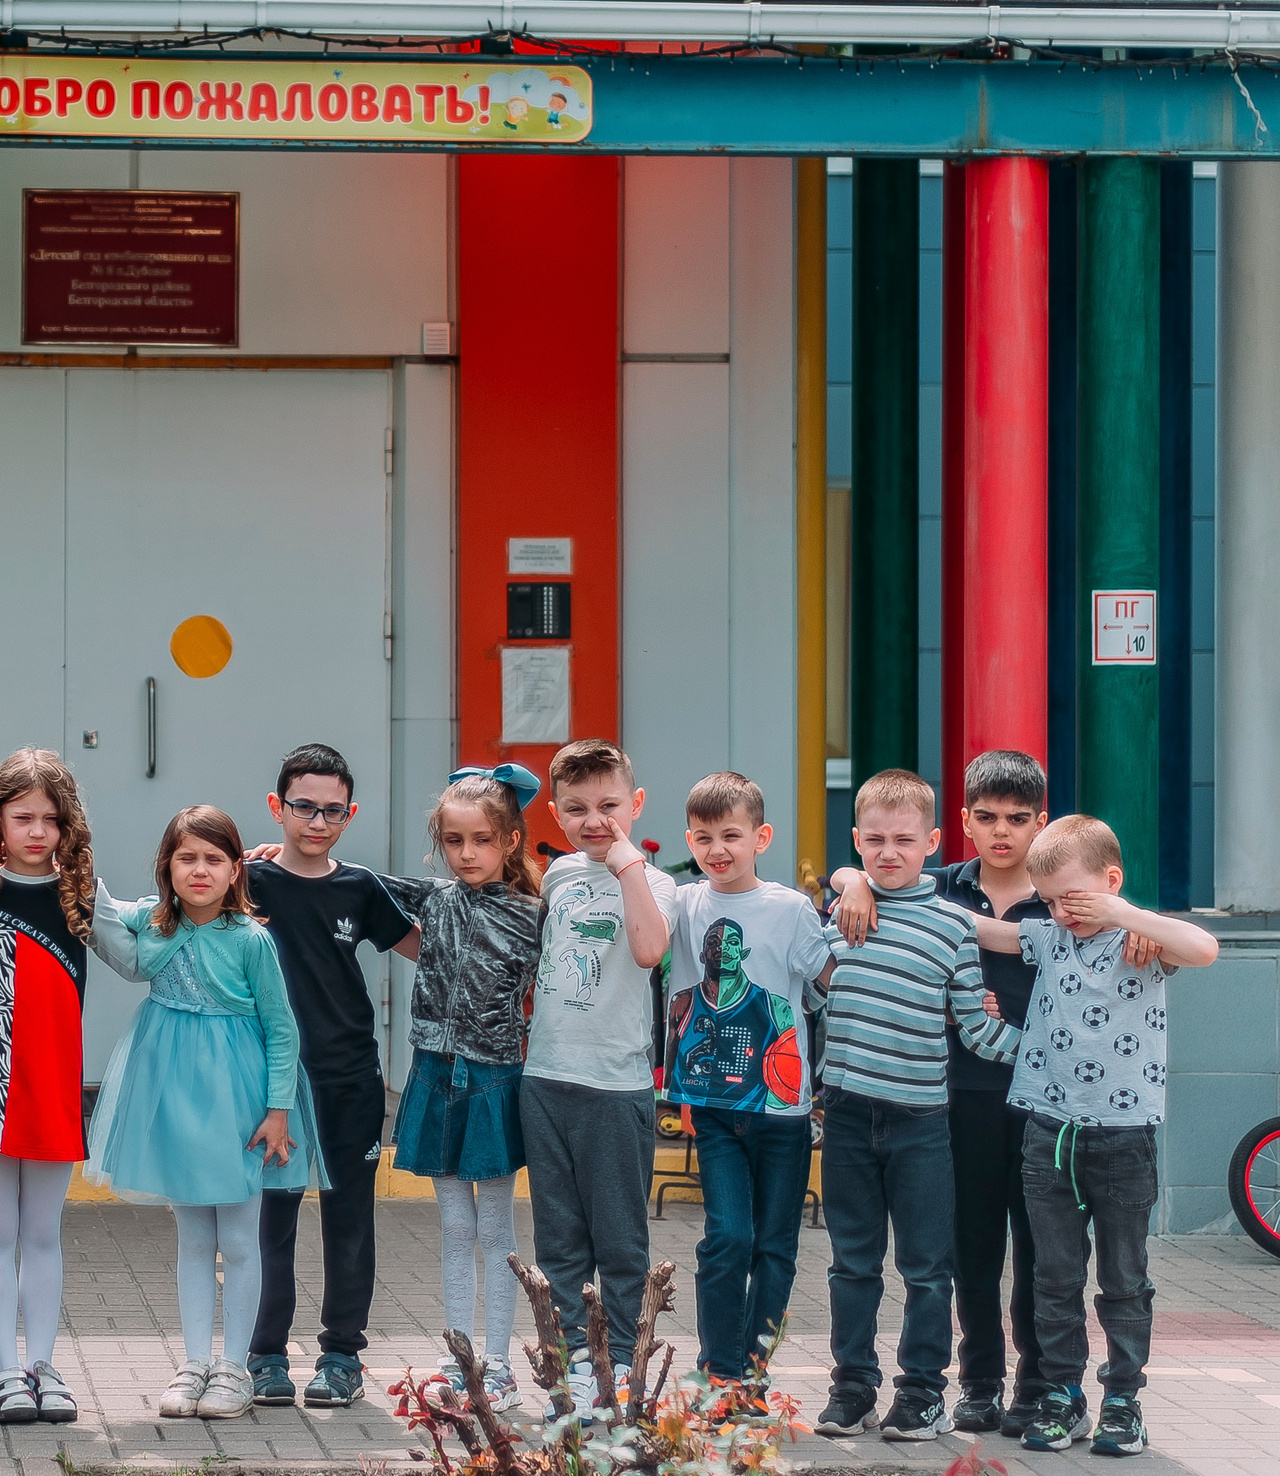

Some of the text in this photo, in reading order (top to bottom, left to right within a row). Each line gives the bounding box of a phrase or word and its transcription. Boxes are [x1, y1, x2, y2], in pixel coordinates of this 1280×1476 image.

[131, 79, 490, 122] ПОЖАЛОВАТЬ!
[1115, 600, 1139, 618] ПГ
[1132, 635, 1146, 652] 10
[333, 932, 353, 942] adidas
[11, 918, 49, 946] CREATE
[49, 942, 79, 979] DREAMS
